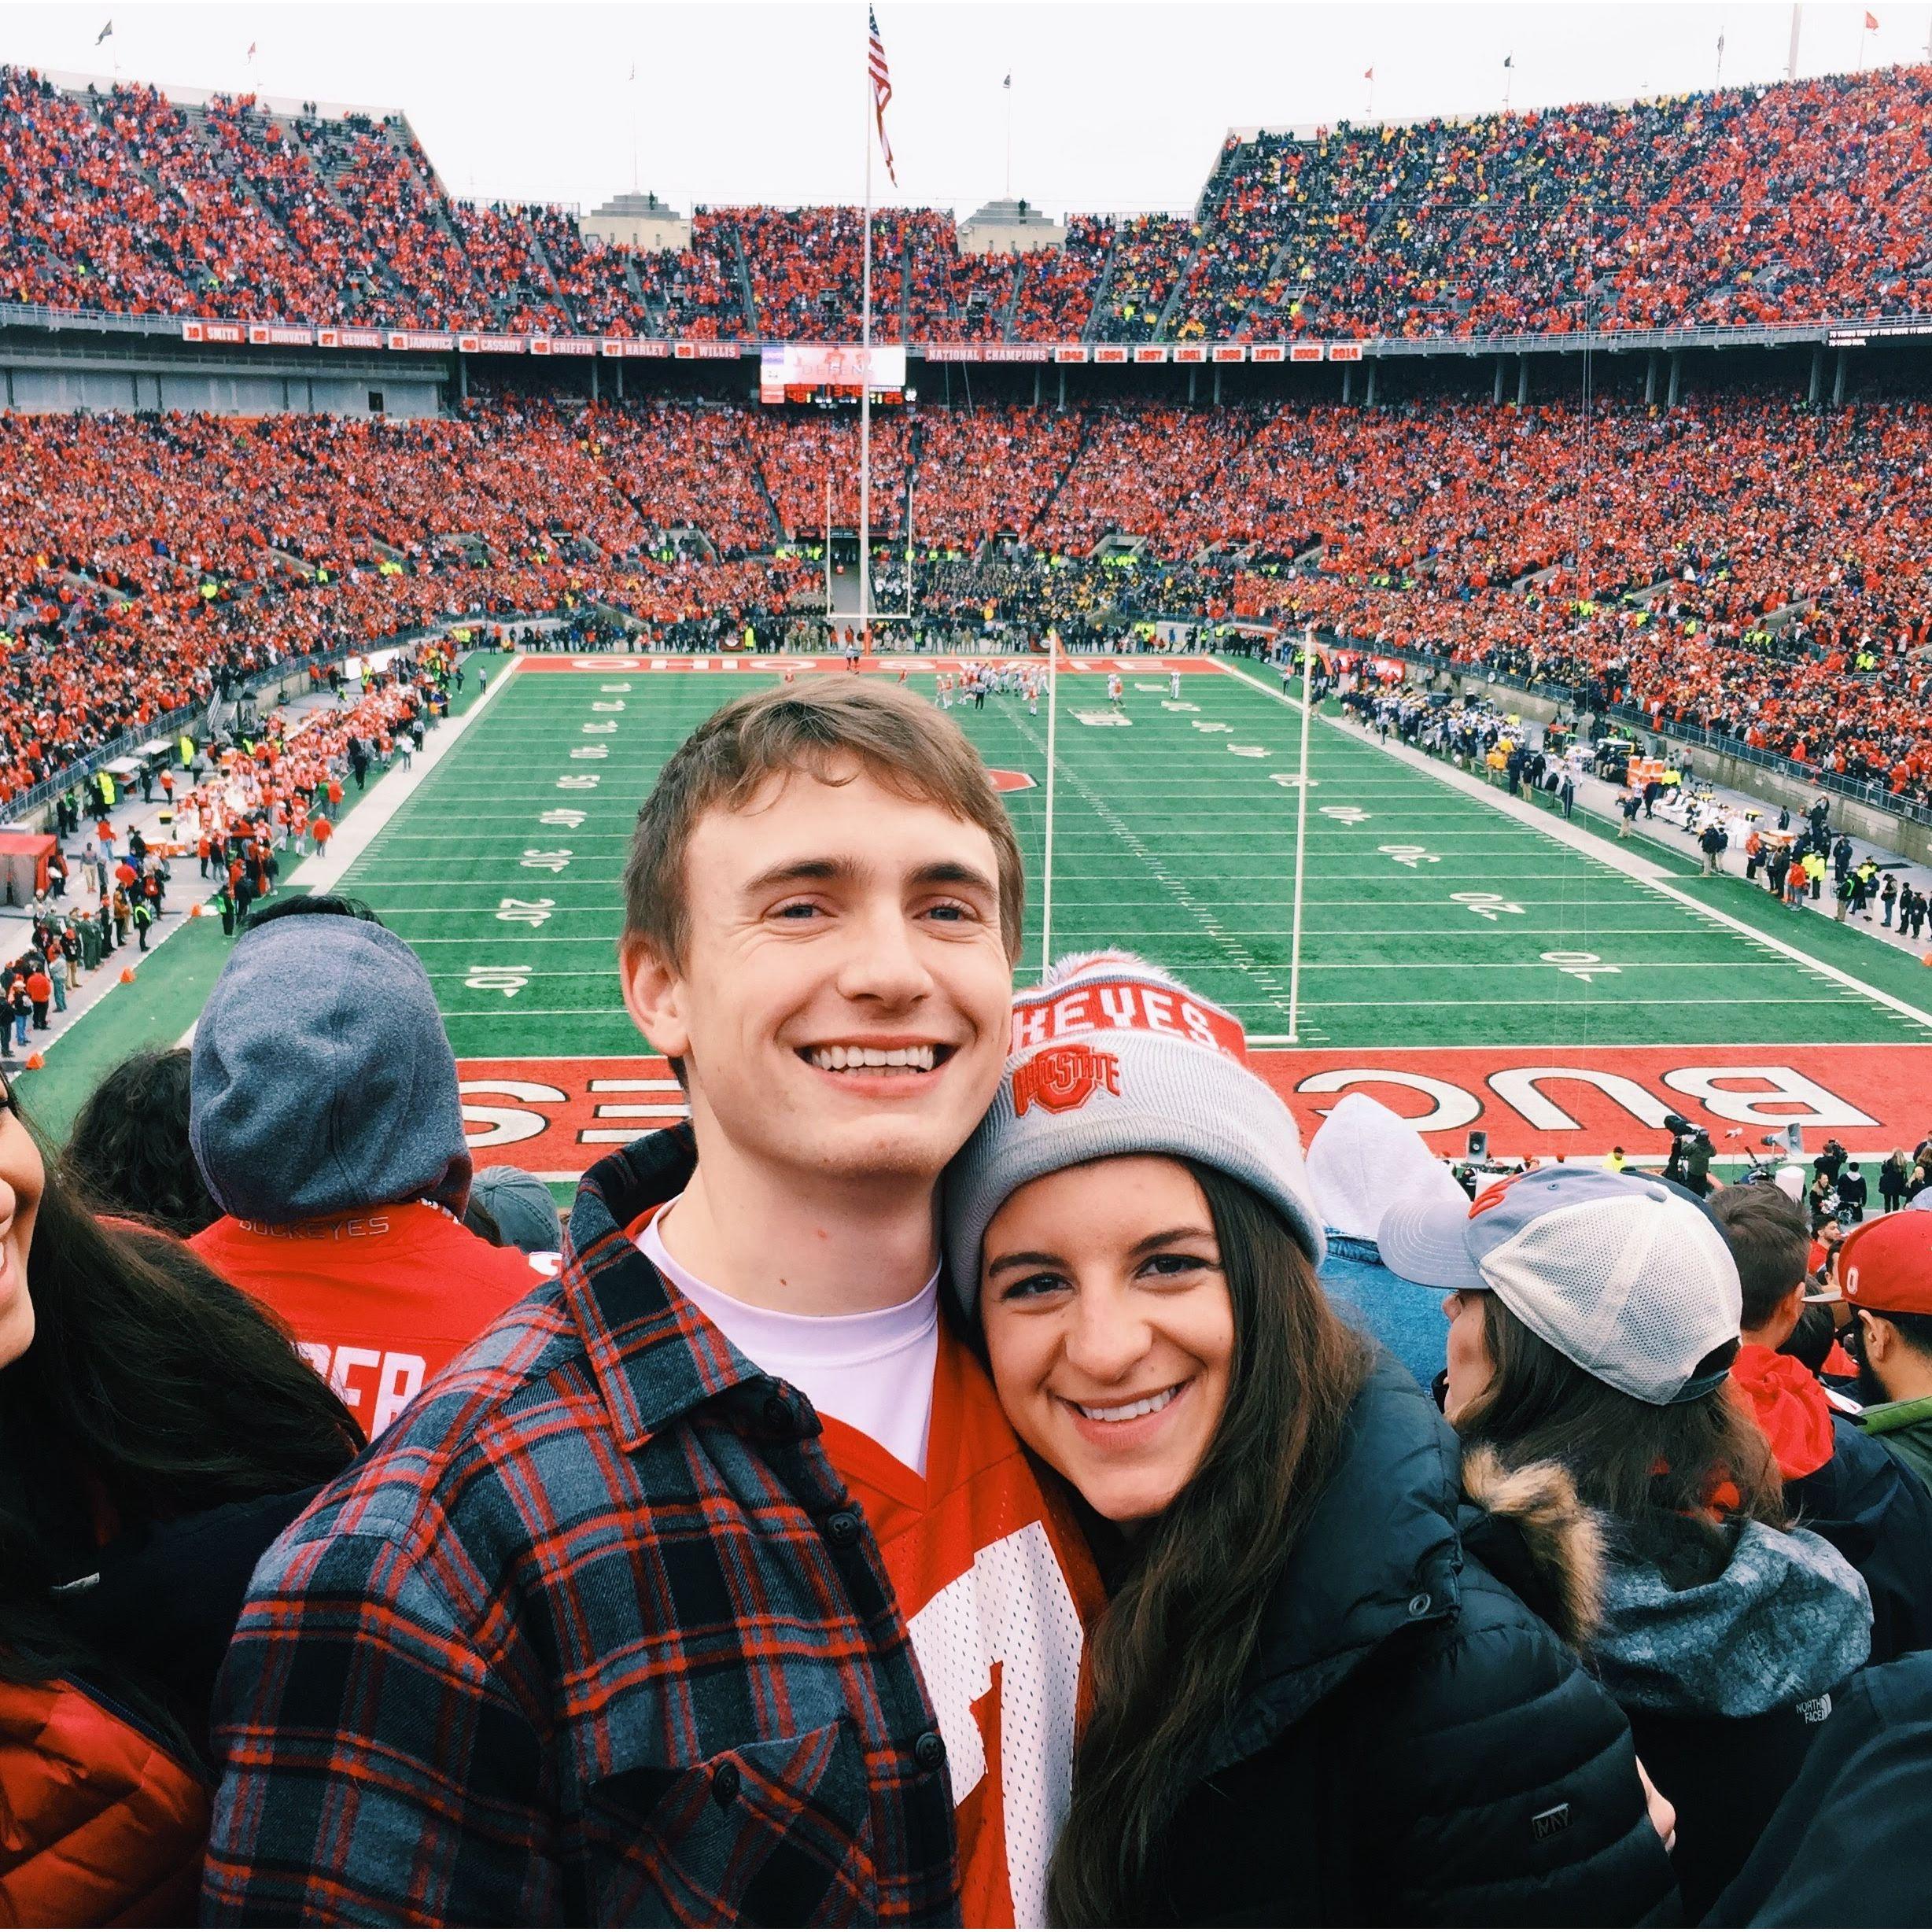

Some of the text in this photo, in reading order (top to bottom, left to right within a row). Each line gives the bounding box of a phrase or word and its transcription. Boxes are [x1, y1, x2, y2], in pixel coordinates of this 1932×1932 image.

[206, 326, 238, 341] SMITH
[321, 333, 378, 347] 27 GEORGE
[480, 339, 520, 352] CASSADY
[552, 342, 592, 354] GRIFFIN
[607, 345, 618, 356] 47
[699, 346, 735, 358] WILLIS
[928, 349, 1045, 361] NATIONAL CHAMPIONS
[1137, 350, 1162, 360] 1957
[1254, 349, 1278, 359] 1970
[1331, 348, 1356, 359] 2014
[571, 659, 813, 670] OHIO
[519, 849, 573, 868] 30
[1377, 845, 1440, 863] 30
[496, 898, 555, 920] 20
[1449, 892, 1525, 913] 20
[1539, 951, 1622, 974] 10
[463, 965, 532, 989] 10
[1055, 1052, 1121, 1097] STATE
[1795, 1698, 1821, 1714] NORTH
[1804, 1709, 1823, 1724] FACE
